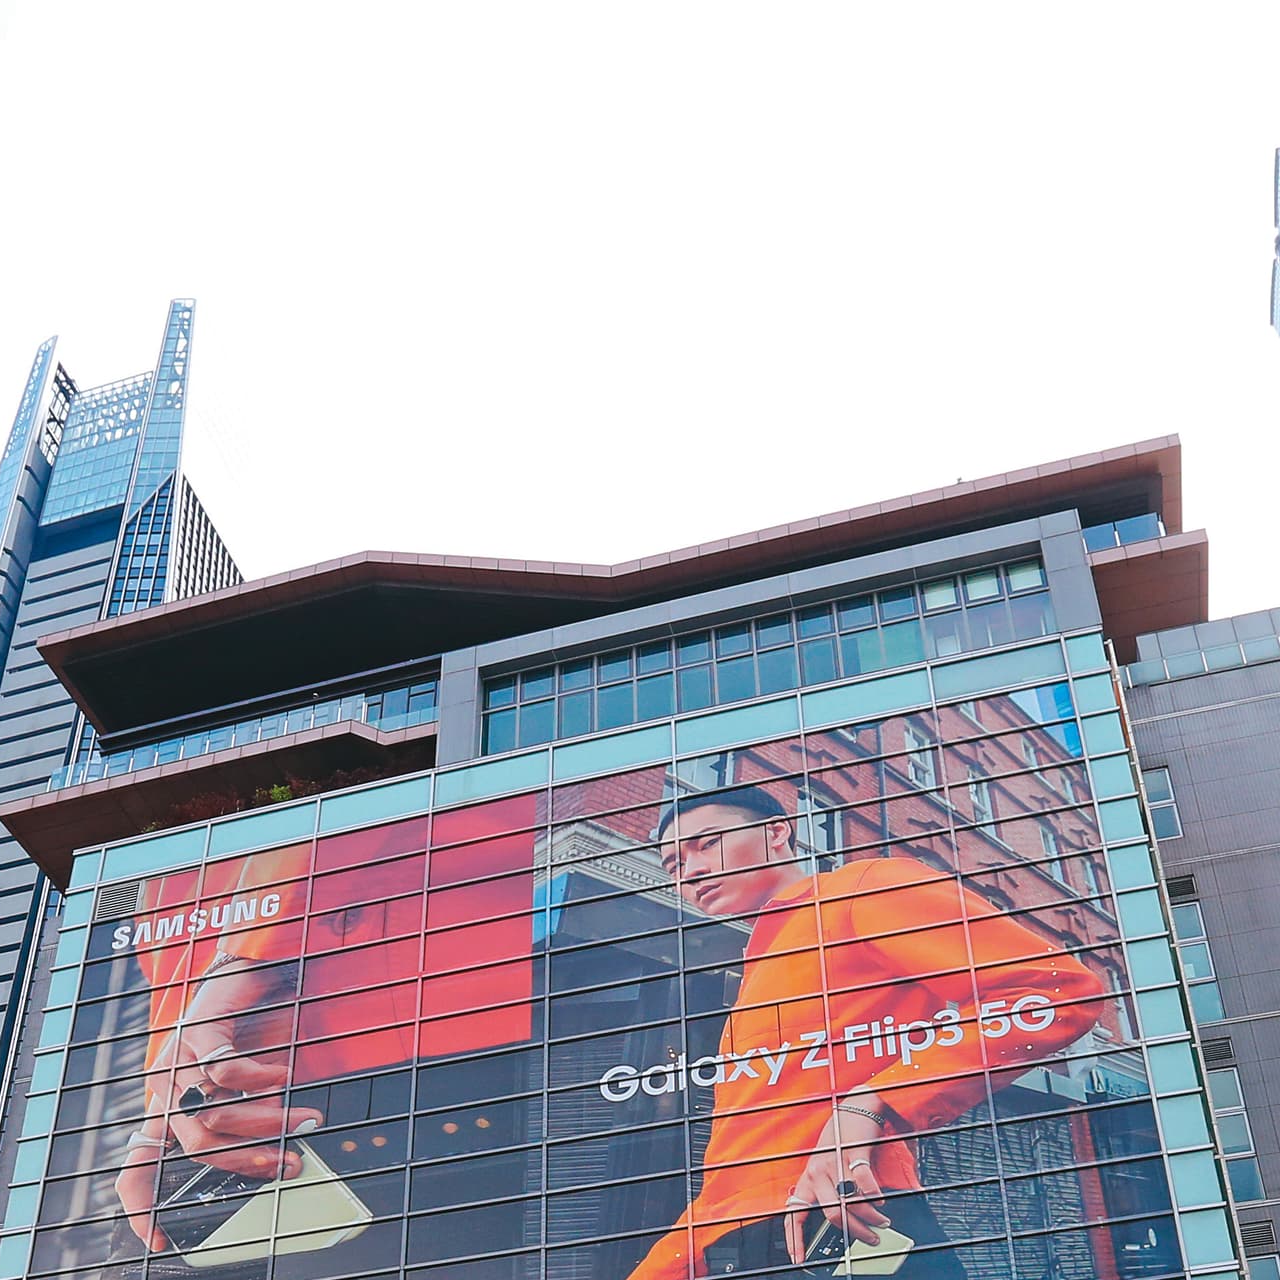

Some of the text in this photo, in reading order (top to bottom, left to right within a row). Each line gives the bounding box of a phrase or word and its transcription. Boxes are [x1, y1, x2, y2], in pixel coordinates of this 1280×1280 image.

[112, 894, 280, 949] SAMSUNG
[599, 994, 1056, 1102] Galaxy Z Flip3 5G
